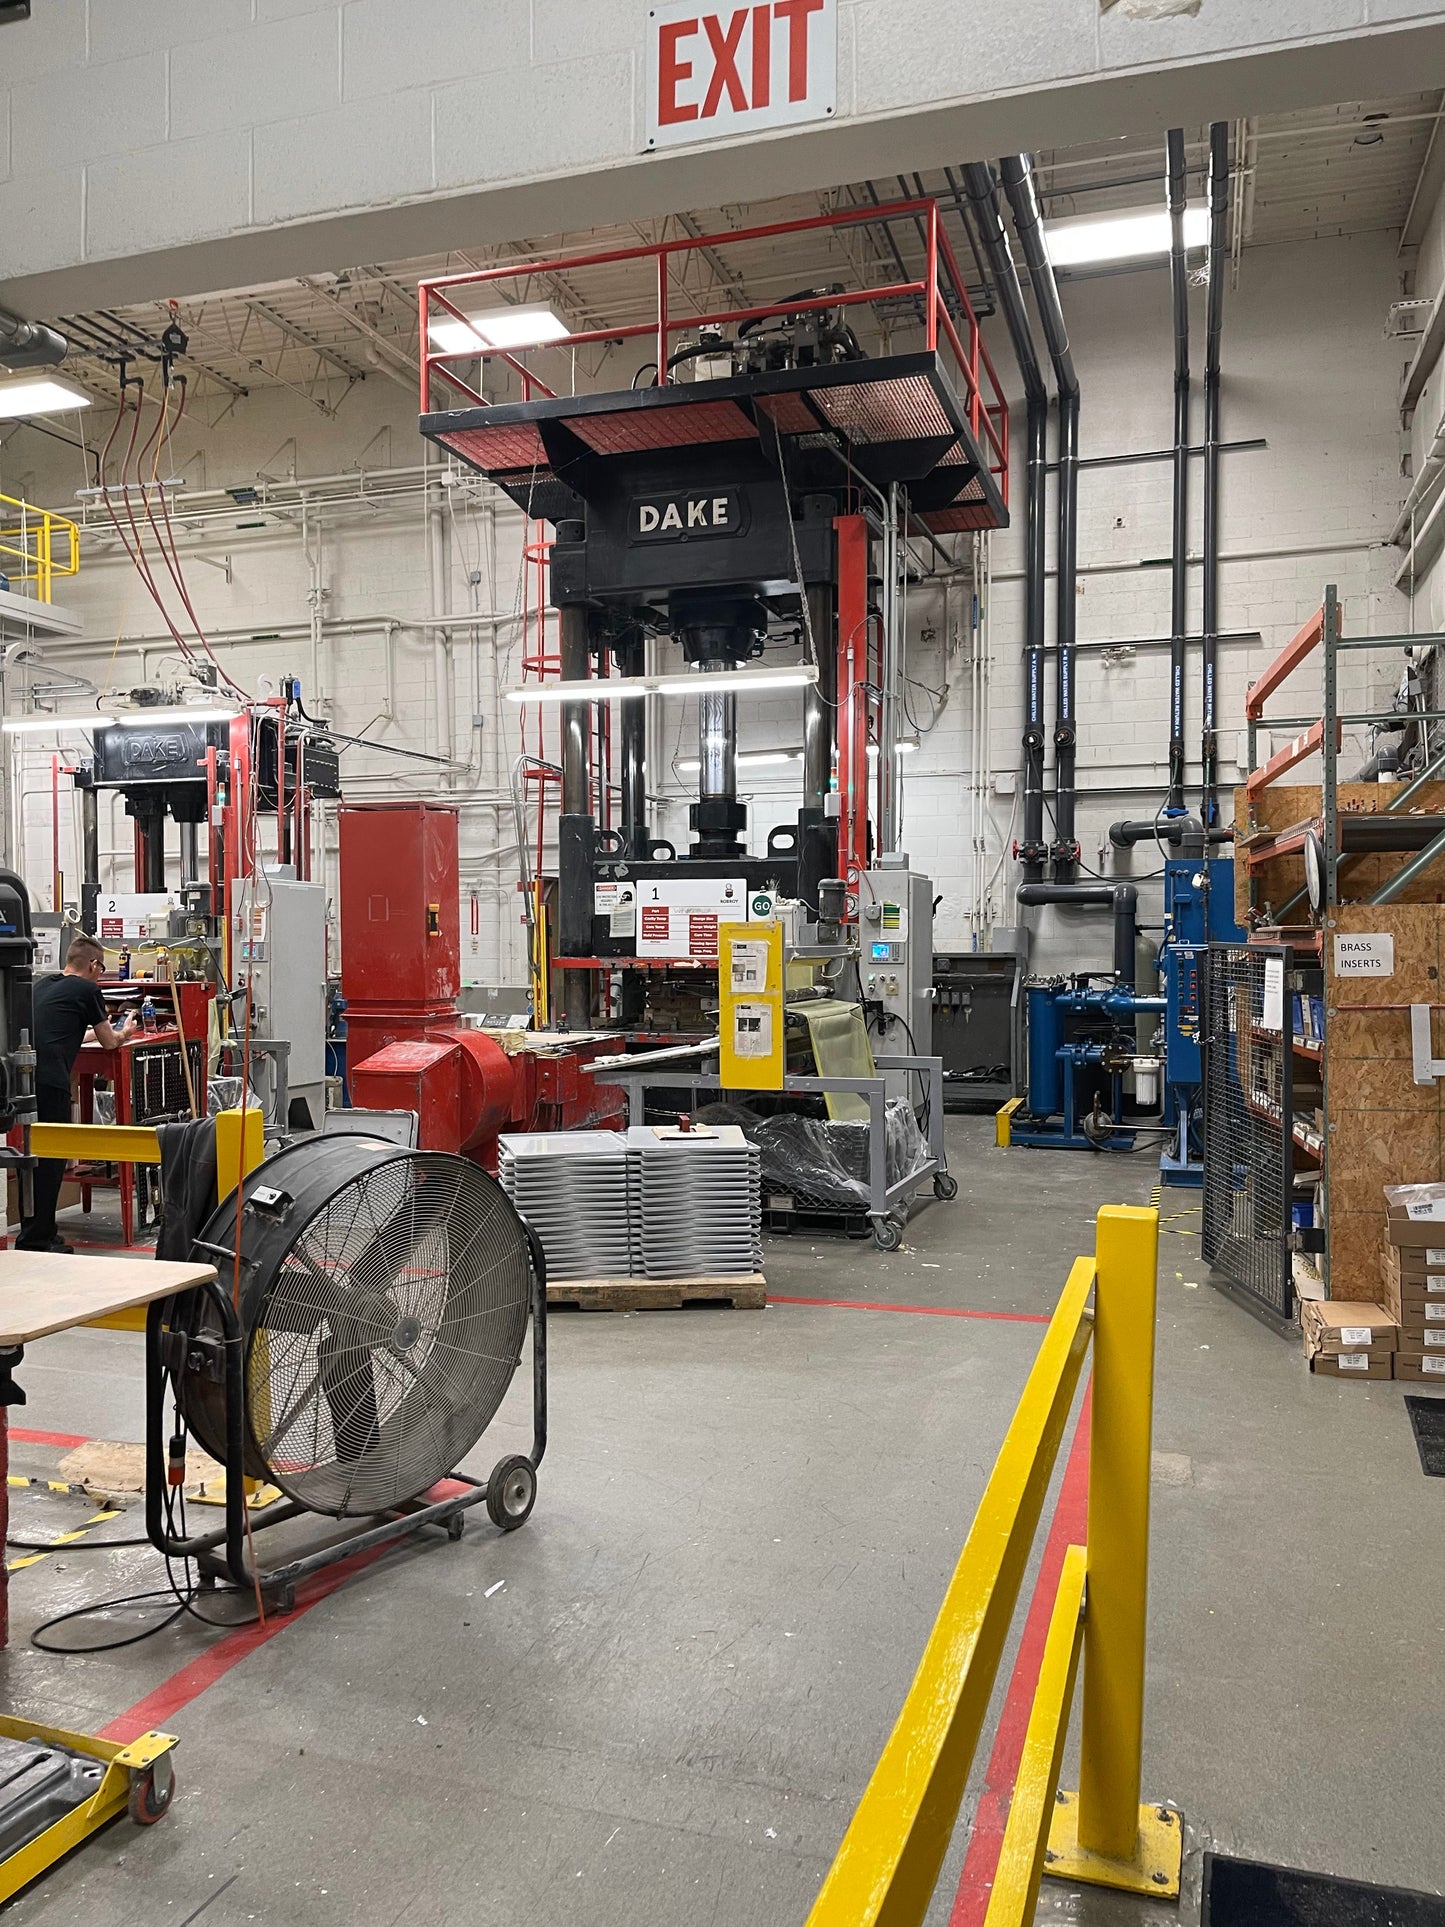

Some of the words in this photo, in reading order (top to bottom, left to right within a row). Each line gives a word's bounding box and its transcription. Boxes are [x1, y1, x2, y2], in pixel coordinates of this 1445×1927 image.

[658, 0, 824, 127] EXIT
[639, 497, 728, 533] DAKE
[130, 739, 178, 760] DAKE
[651, 887, 660, 900] 1
[108, 900, 116, 912] 2
[754, 901, 770, 911] GO
[1340, 942, 1372, 952] BRASS
[1341, 959, 1382, 968] INSERTS
